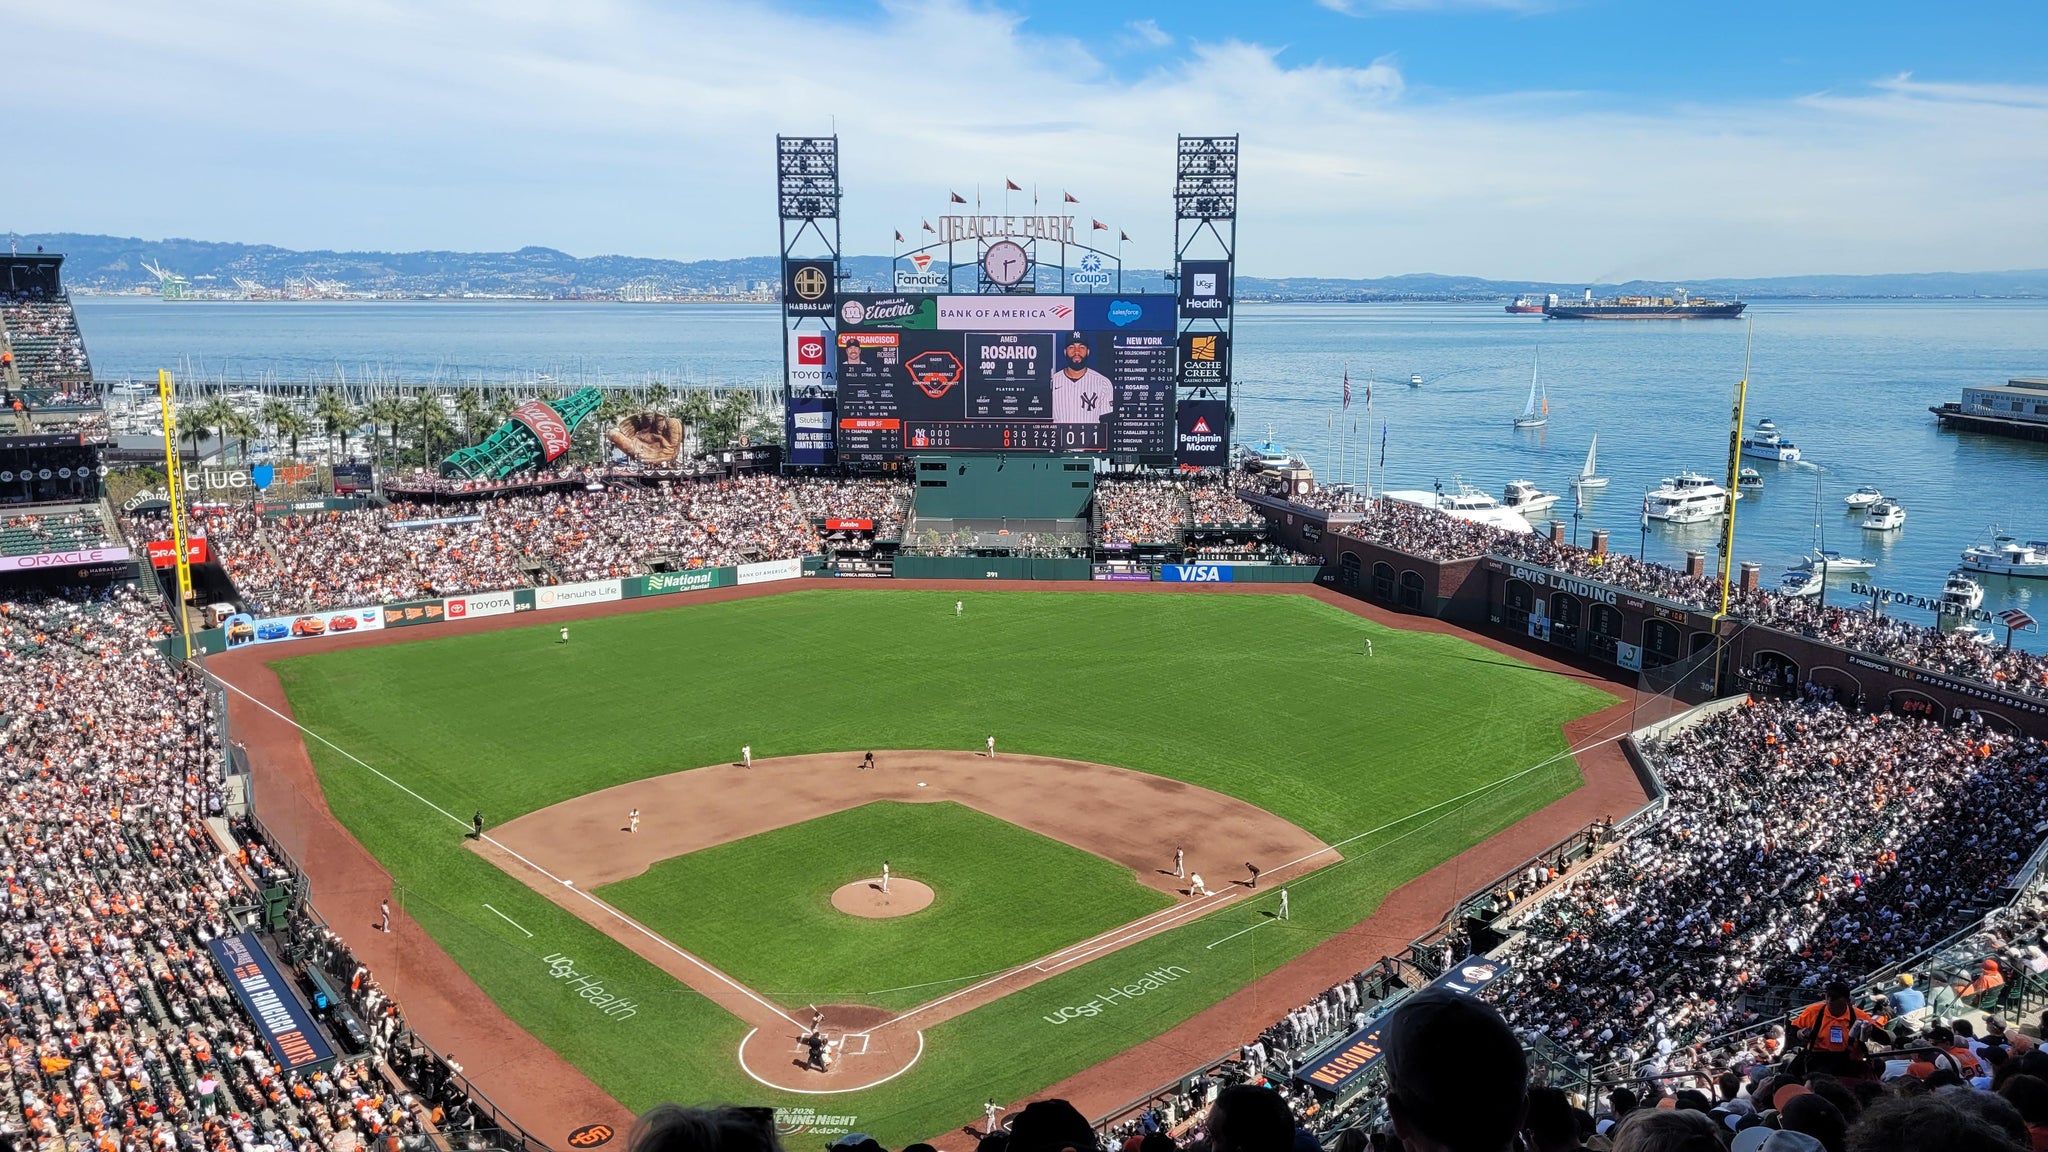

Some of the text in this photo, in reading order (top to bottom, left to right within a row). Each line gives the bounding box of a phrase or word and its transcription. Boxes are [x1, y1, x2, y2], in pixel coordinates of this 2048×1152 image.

[939, 216, 1075, 244] ORACLE PARK
[896, 273, 948, 286] Fanatics
[1074, 274, 1108, 285] coupa
[1196, 280, 1213, 289] UCSF
[1186, 298, 1222, 308] Health
[865, 302, 915, 320] Electric
[941, 310, 1046, 318] BANK OF AMERICA
[981, 346, 1037, 359] ROSARIO
[792, 371, 834, 380] TOYOTA
[1066, 432, 1098, 444] 0 1 1
[1180, 434, 1221, 443] Benjamin
[794, 441, 834, 449] GIANTS TICKETS
[1186, 443, 1216, 451] Moore
[184, 468, 246, 491] blue
[18, 551, 103, 567] ORACLE
[150, 547, 200, 558] ORALE
[663, 572, 712, 586] National
[1175, 566, 1220, 581] VISA
[557, 587, 617, 601] Hanwha Life
[1550, 576, 1616, 605] LANDING
[470, 600, 510, 611] TOYOTA
[1851, 583, 1993, 623] BANK OF AMERICA
[192, 647, 207, 656] 39
[1856, 659, 1889, 672] PRIZEPICKS
[1894, 668, 1901, 676] K
[1700, 683, 1714, 692] 309
[543, 953, 638, 1021] UCSF Health
[1043, 966, 1191, 1024] UCSF Health
[240, 975, 317, 1064] SAN FRANCISCO GIANTS
[1310, 1041, 1381, 1085] WELCOME
[776, 1114, 857, 1126] ENING NIGHT
